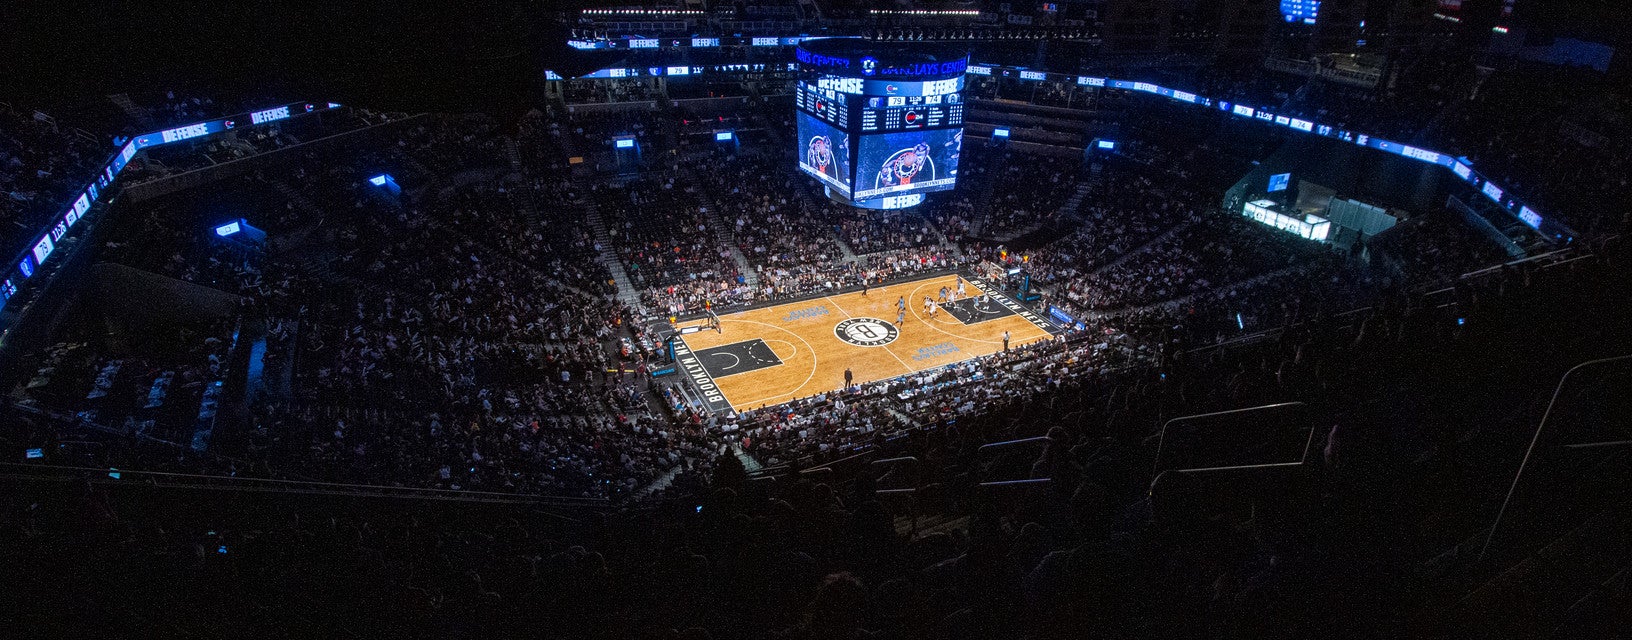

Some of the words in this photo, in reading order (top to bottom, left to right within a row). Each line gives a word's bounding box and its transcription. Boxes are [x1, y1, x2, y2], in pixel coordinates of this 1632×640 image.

[629, 39, 659, 48] DEFENSE
[752, 37, 779, 46] DEFENSE
[966, 65, 992, 75] DEFENSE
[1020, 71, 1046, 80] DEFENSE
[818, 78, 864, 95] DEFENSE
[922, 77, 959, 97] DEFENSE
[1078, 77, 1105, 86] DEFENSE
[251, 106, 290, 125] DEFENSE
[161, 122, 208, 144] DEFENSE
[1020, 311, 1050, 329] NETS
[855, 324, 878, 338] B
[682, 357, 723, 402] BROOKLYN
